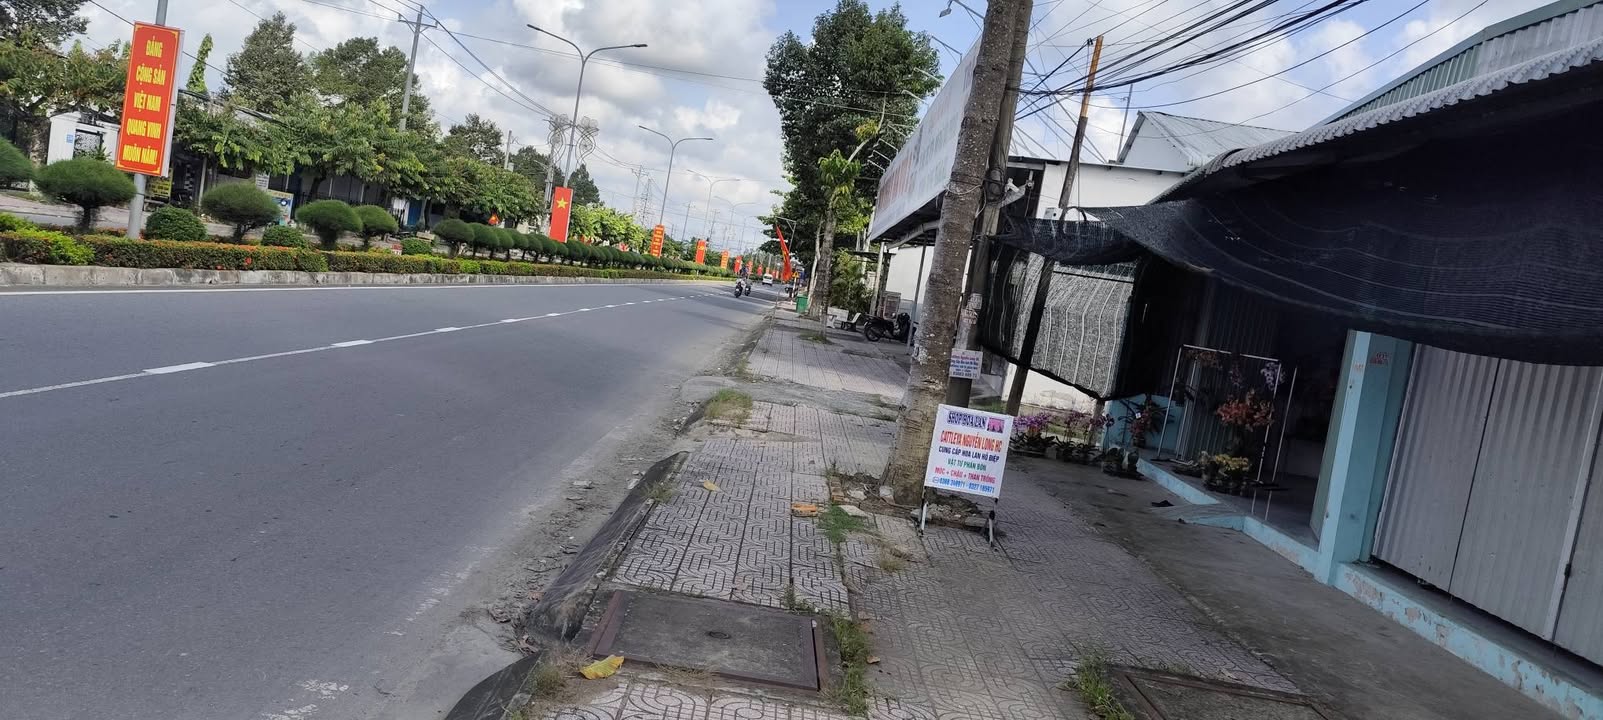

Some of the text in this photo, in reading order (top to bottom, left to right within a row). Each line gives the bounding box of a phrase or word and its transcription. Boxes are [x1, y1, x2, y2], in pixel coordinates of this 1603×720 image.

[146, 36, 163, 57] ĐẢNG
[136, 63, 166, 86] CỘNG SẢN
[134, 90, 161, 112] VIỆT NAM
[126, 118, 161, 139] QUANG VINH
[123, 143, 158, 165] MUÔN NĂM!
[948, 412, 987, 428] SHOP HOA LAN
[941, 430, 962, 446] CATTLEYA
[982, 436, 995, 451] LONG
[939, 446, 951, 454] CUNG
[952, 447, 961, 456] CẤP
[972, 451, 980, 459] LAN
[982, 452, 988, 461] HỒ
[989, 455, 999, 463] ĐIỆP
[948, 458, 956, 467] VẬT
[964, 460, 976, 469] PHÂN
